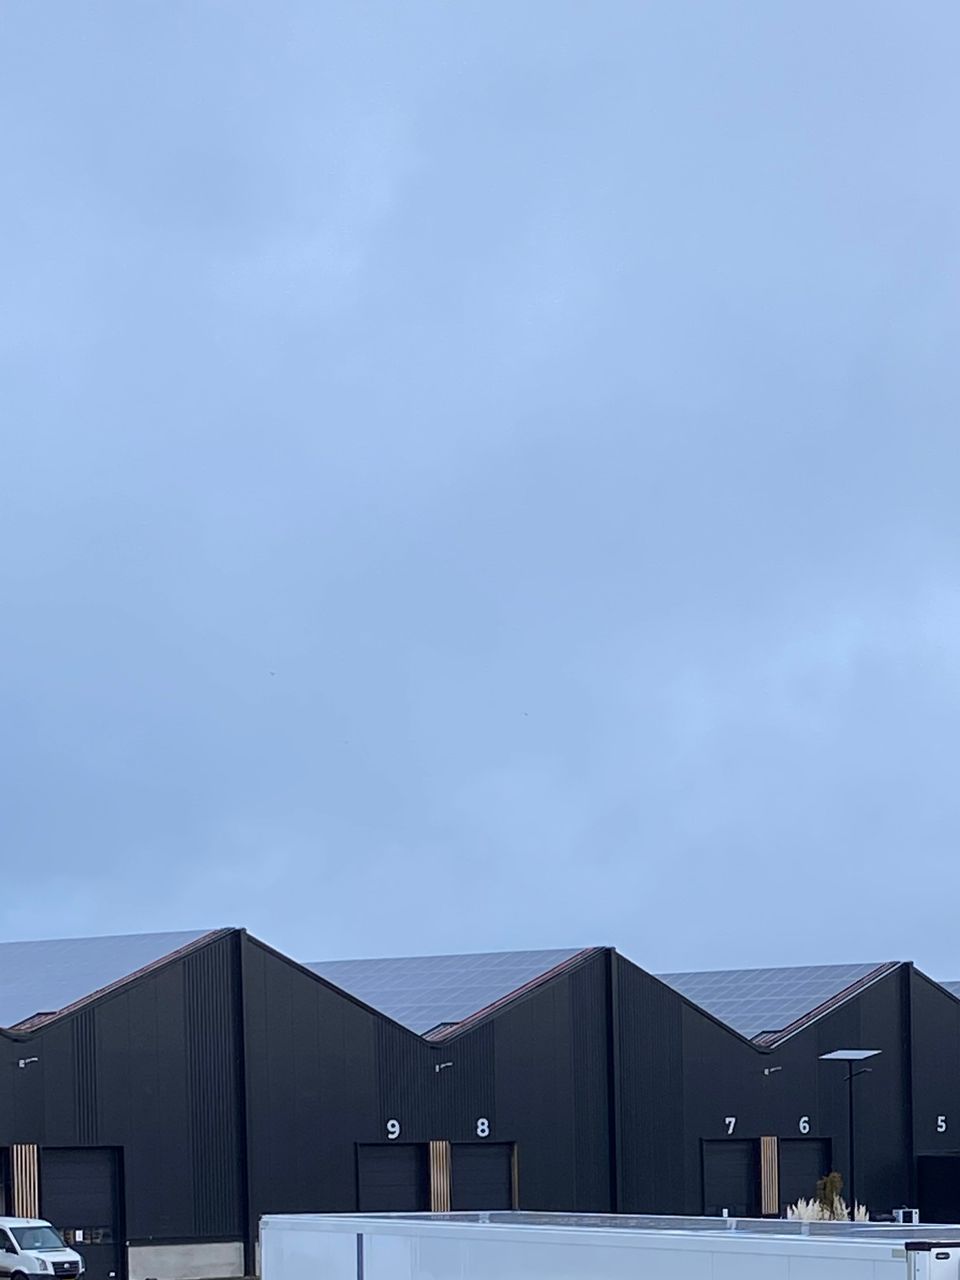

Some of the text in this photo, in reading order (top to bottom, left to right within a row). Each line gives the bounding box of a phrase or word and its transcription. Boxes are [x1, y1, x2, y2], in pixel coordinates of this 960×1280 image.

[386, 1119, 400, 1139] 9
[476, 1117, 489, 1137] 8
[725, 1117, 736, 1134] 7
[799, 1116, 810, 1134] 6
[936, 1115, 947, 1132] 5
